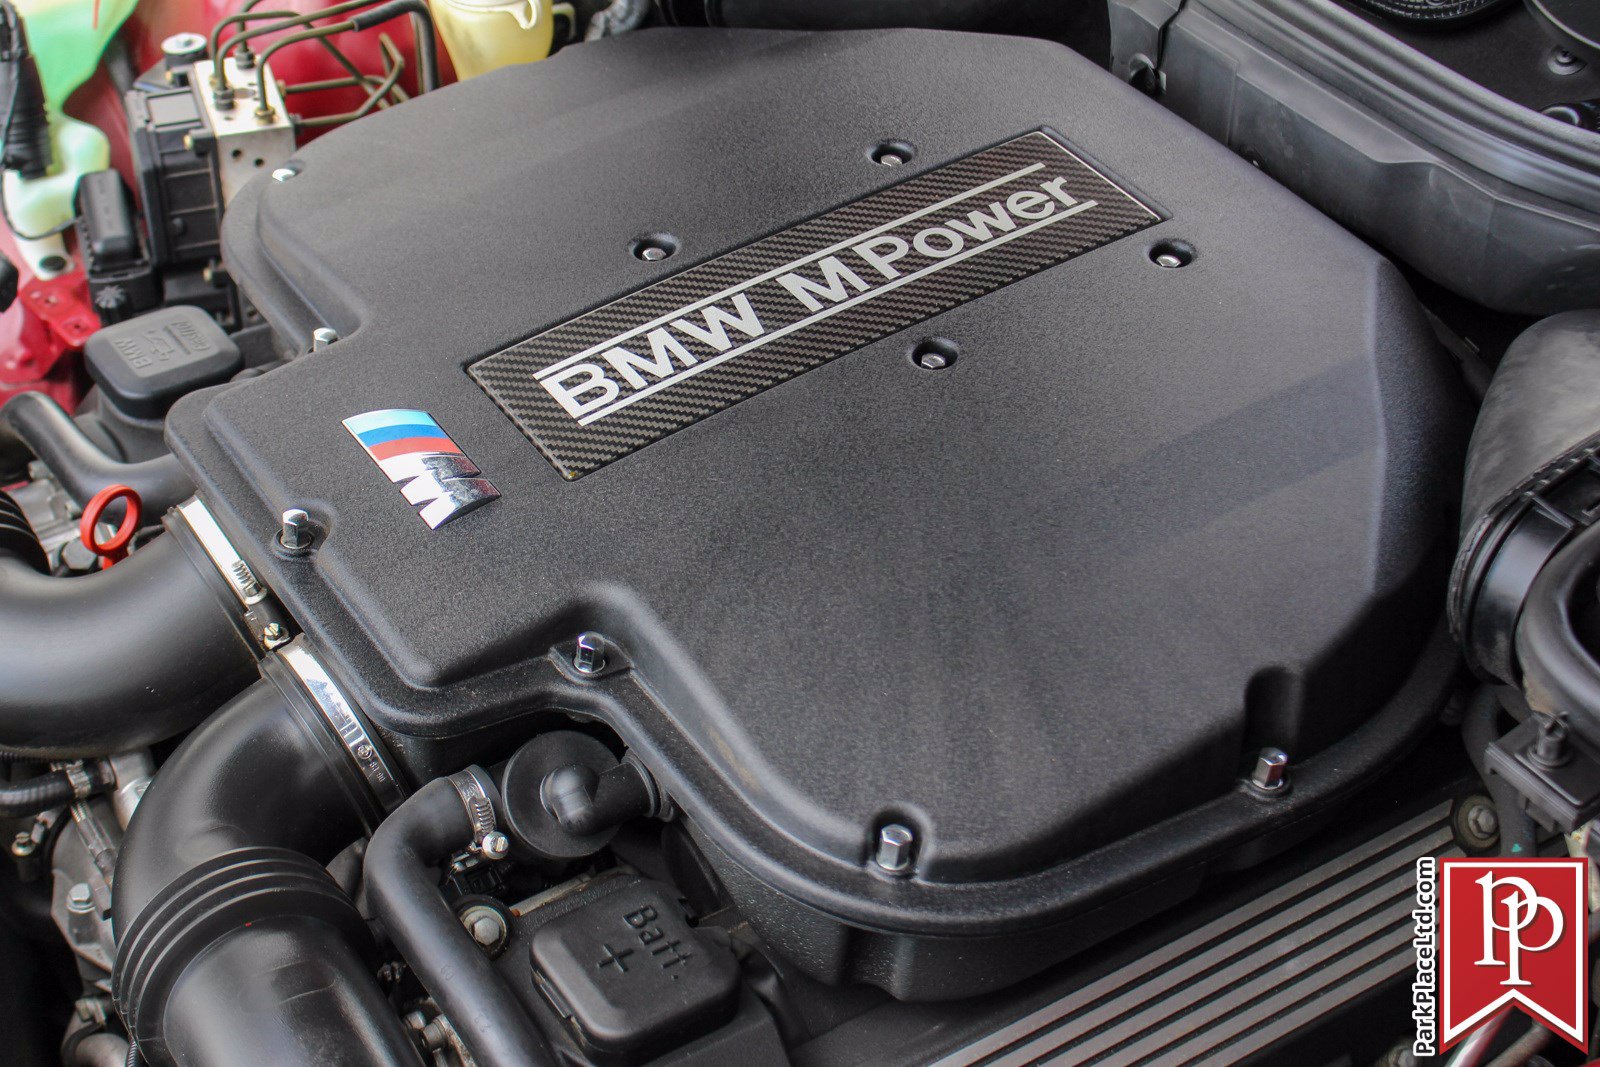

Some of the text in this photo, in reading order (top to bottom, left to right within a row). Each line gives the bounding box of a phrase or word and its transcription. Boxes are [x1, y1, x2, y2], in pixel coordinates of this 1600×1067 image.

[113, 338, 153, 370] BMW
[540, 292, 766, 418] BMW
[622, 904, 692, 981] Batt.
